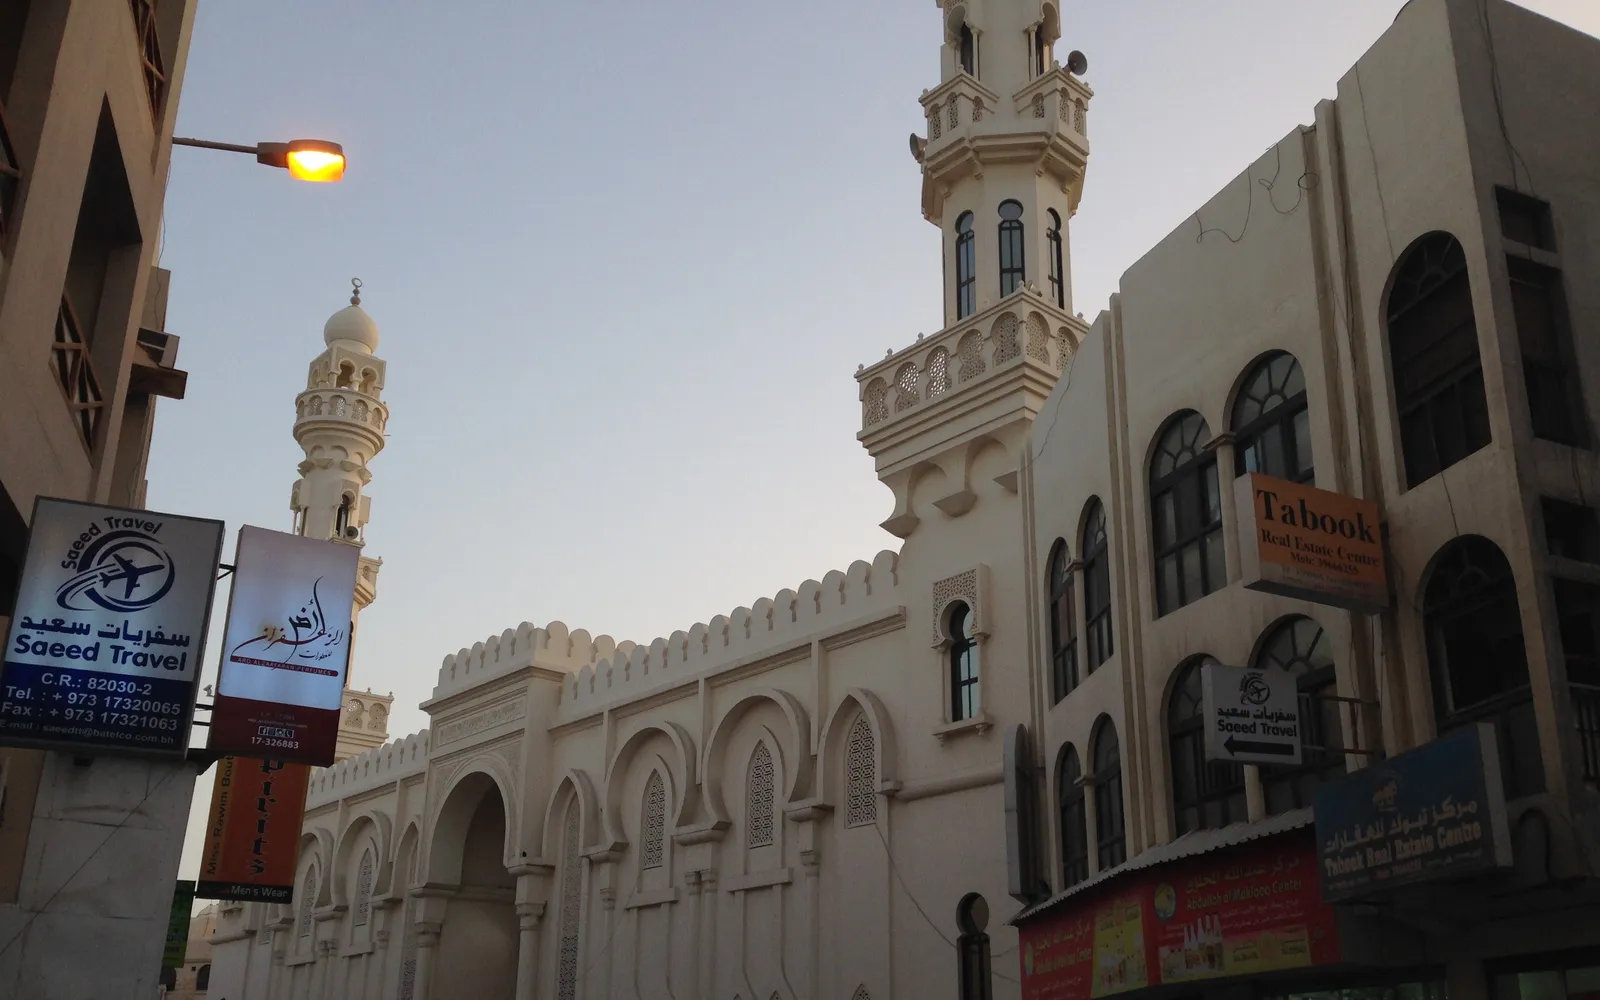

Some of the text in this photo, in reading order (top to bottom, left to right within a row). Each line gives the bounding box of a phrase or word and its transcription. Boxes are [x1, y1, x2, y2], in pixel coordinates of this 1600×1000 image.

[1257, 488, 1376, 544] Tabook
[61, 516, 162, 570] Saeed Travel
[1261, 529, 1379, 566] Real Estate Centre
[20, 616, 190, 647] سفريات سعيد
[14, 635, 187, 672] Saeed Travel
[87, 677, 152, 696] 82030-2
[1, 702, 32, 717] Fax
[64, 708, 95, 723] 973
[100, 712, 178, 731] 17321063
[67, 692, 97, 707] 973
[104, 697, 181, 715] 17320065
[1217, 706, 1297, 723] سفريات سعيد
[250, 736, 300, 749] 17-326883
[1217, 719, 1297, 737] Saeed Travel
[1432, 794, 1478, 826] مركز
[207, 841, 220, 875] Miss
[1324, 850, 1364, 877] Tabook
[1366, 842, 1393, 868] Real
[262, 887, 288, 897] Wear
[1272, 879, 1303, 895] Center
